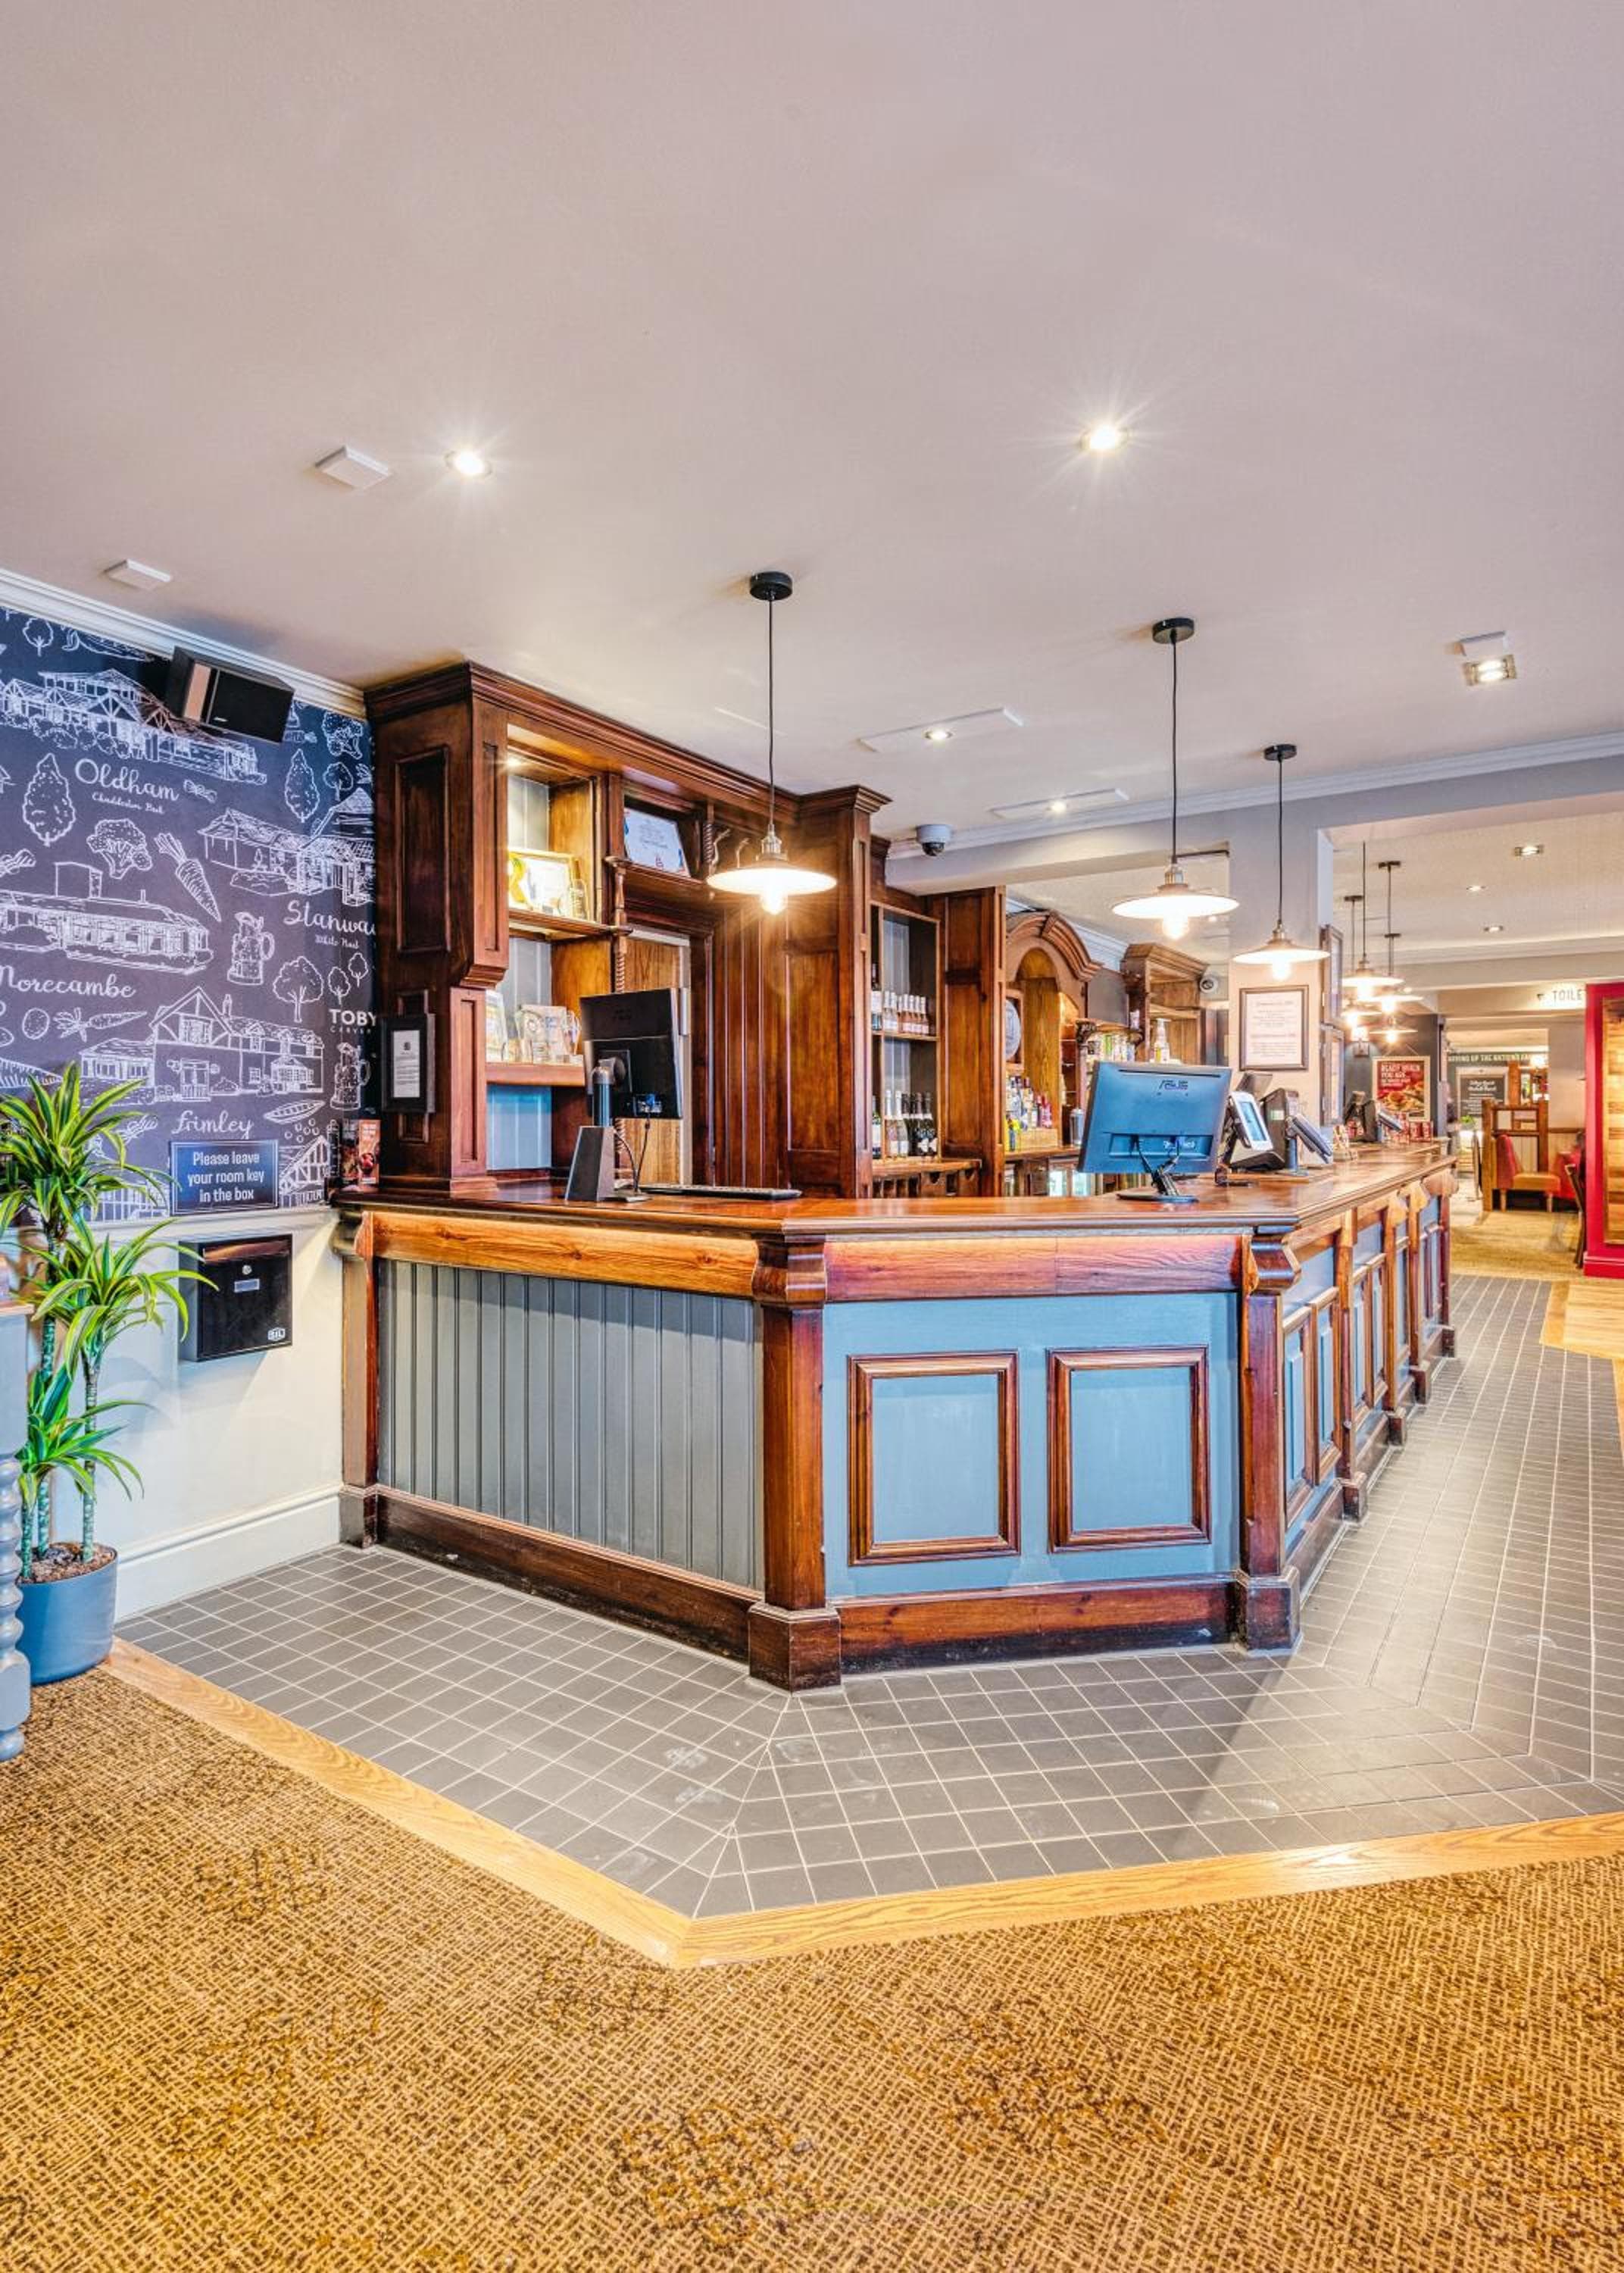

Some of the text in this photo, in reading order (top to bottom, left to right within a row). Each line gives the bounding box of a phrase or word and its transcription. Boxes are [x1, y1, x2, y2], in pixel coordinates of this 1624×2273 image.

[75, 758, 180, 802] Oldham
[329, 1008, 376, 1027] TOBY
[192, 1151, 260, 1166] Please leave
[187, 1168, 265, 1187] your room key
[199, 1187, 255, 1203] in the box
